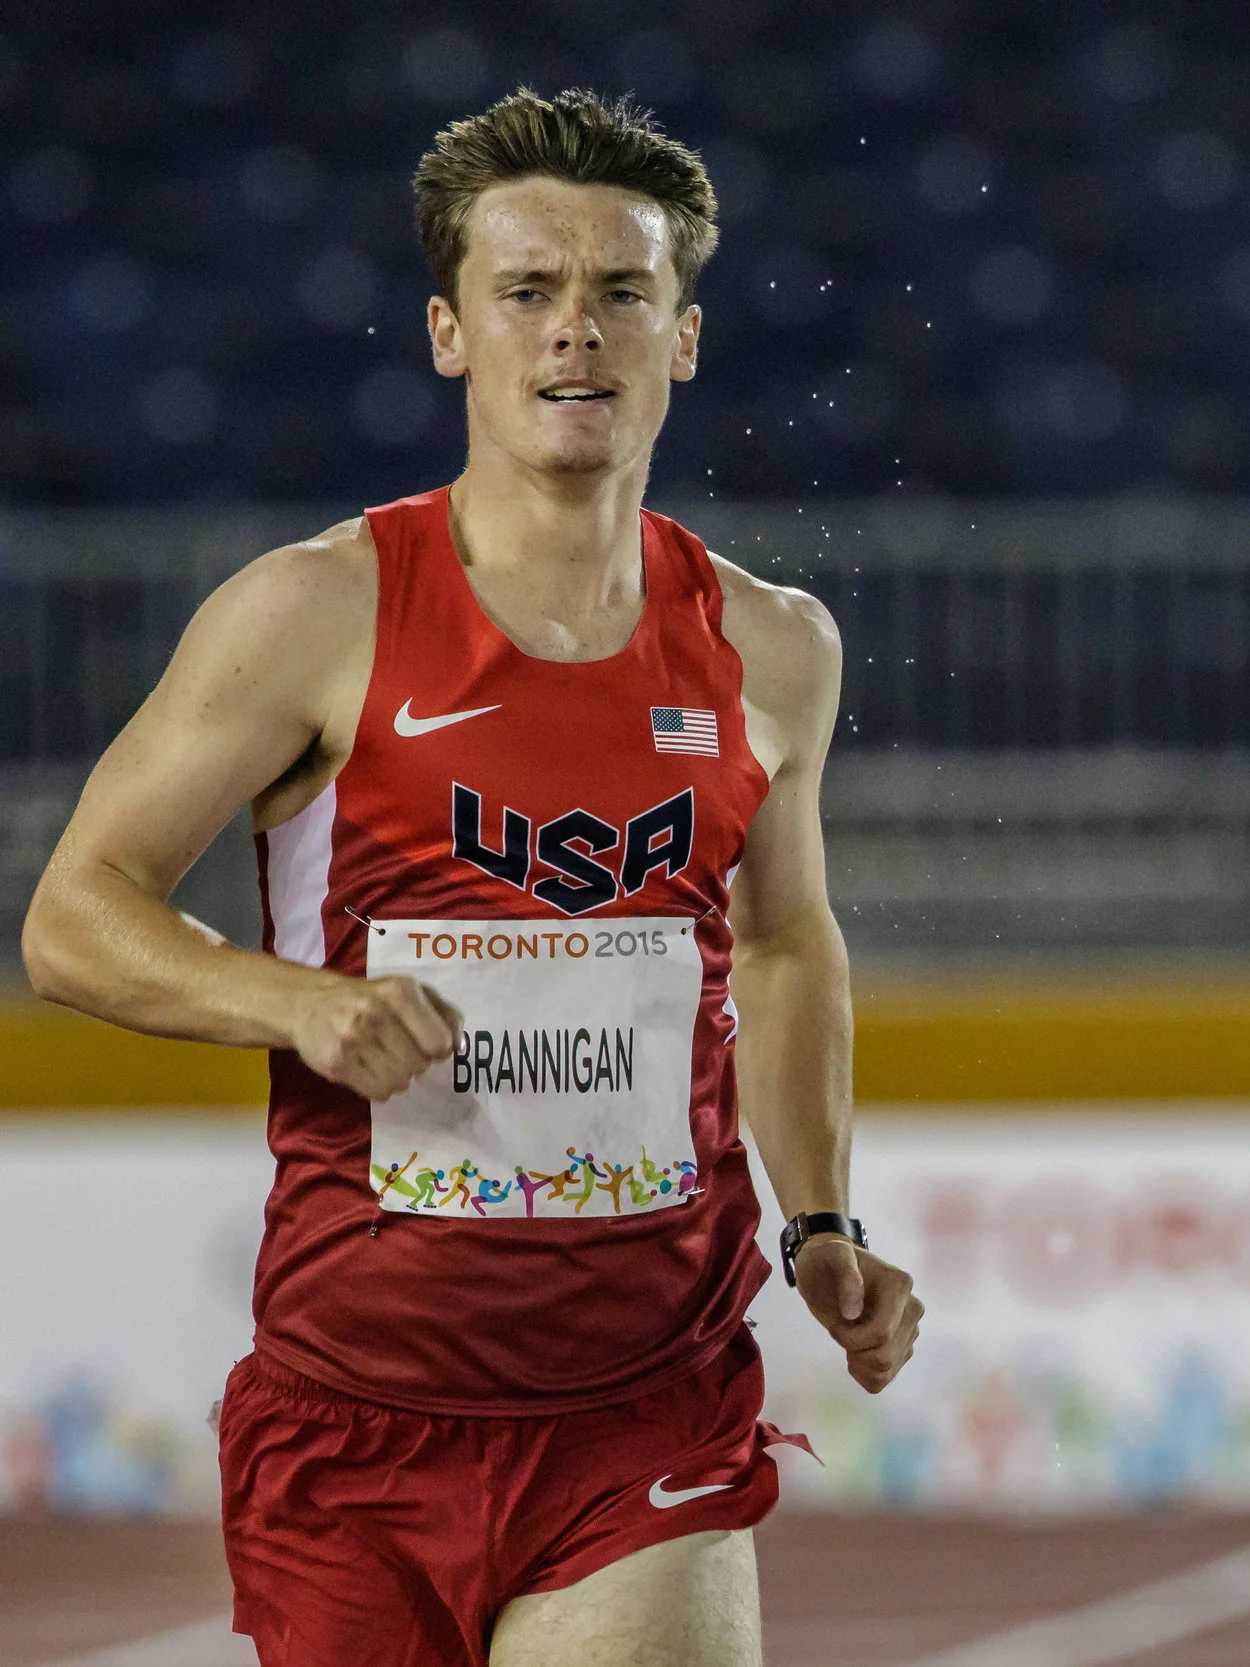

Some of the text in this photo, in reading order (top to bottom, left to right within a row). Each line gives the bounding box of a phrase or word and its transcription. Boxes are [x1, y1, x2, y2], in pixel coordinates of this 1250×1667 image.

[452, 781, 694, 916] USA
[408, 931, 669, 960] TORONTO 2015
[452, 1028, 634, 1094] BRANNIGAN
